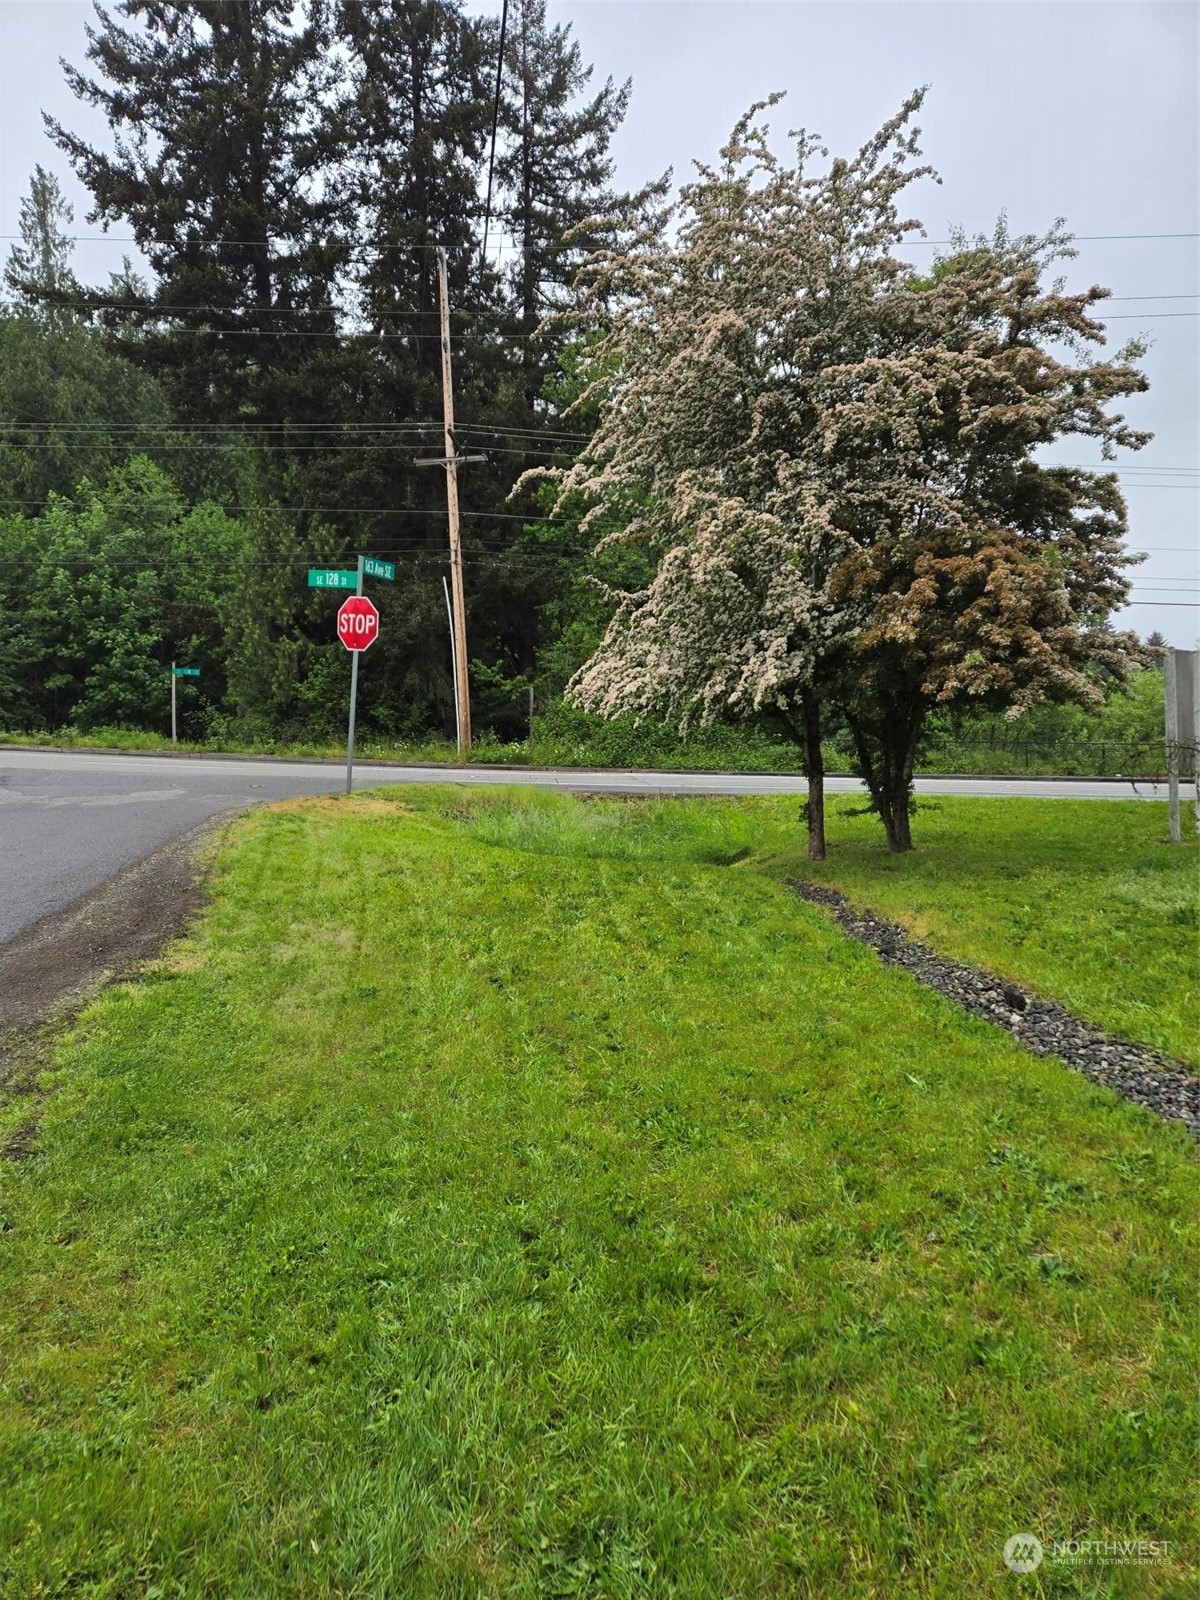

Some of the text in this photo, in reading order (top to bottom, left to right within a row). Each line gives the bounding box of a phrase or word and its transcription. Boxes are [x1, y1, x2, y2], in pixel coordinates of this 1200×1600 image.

[365, 560, 392, 578] 163 Ave SE
[316, 575, 323, 585] SE
[326, 572, 339, 585] 128
[340, 613, 376, 634] STOP
